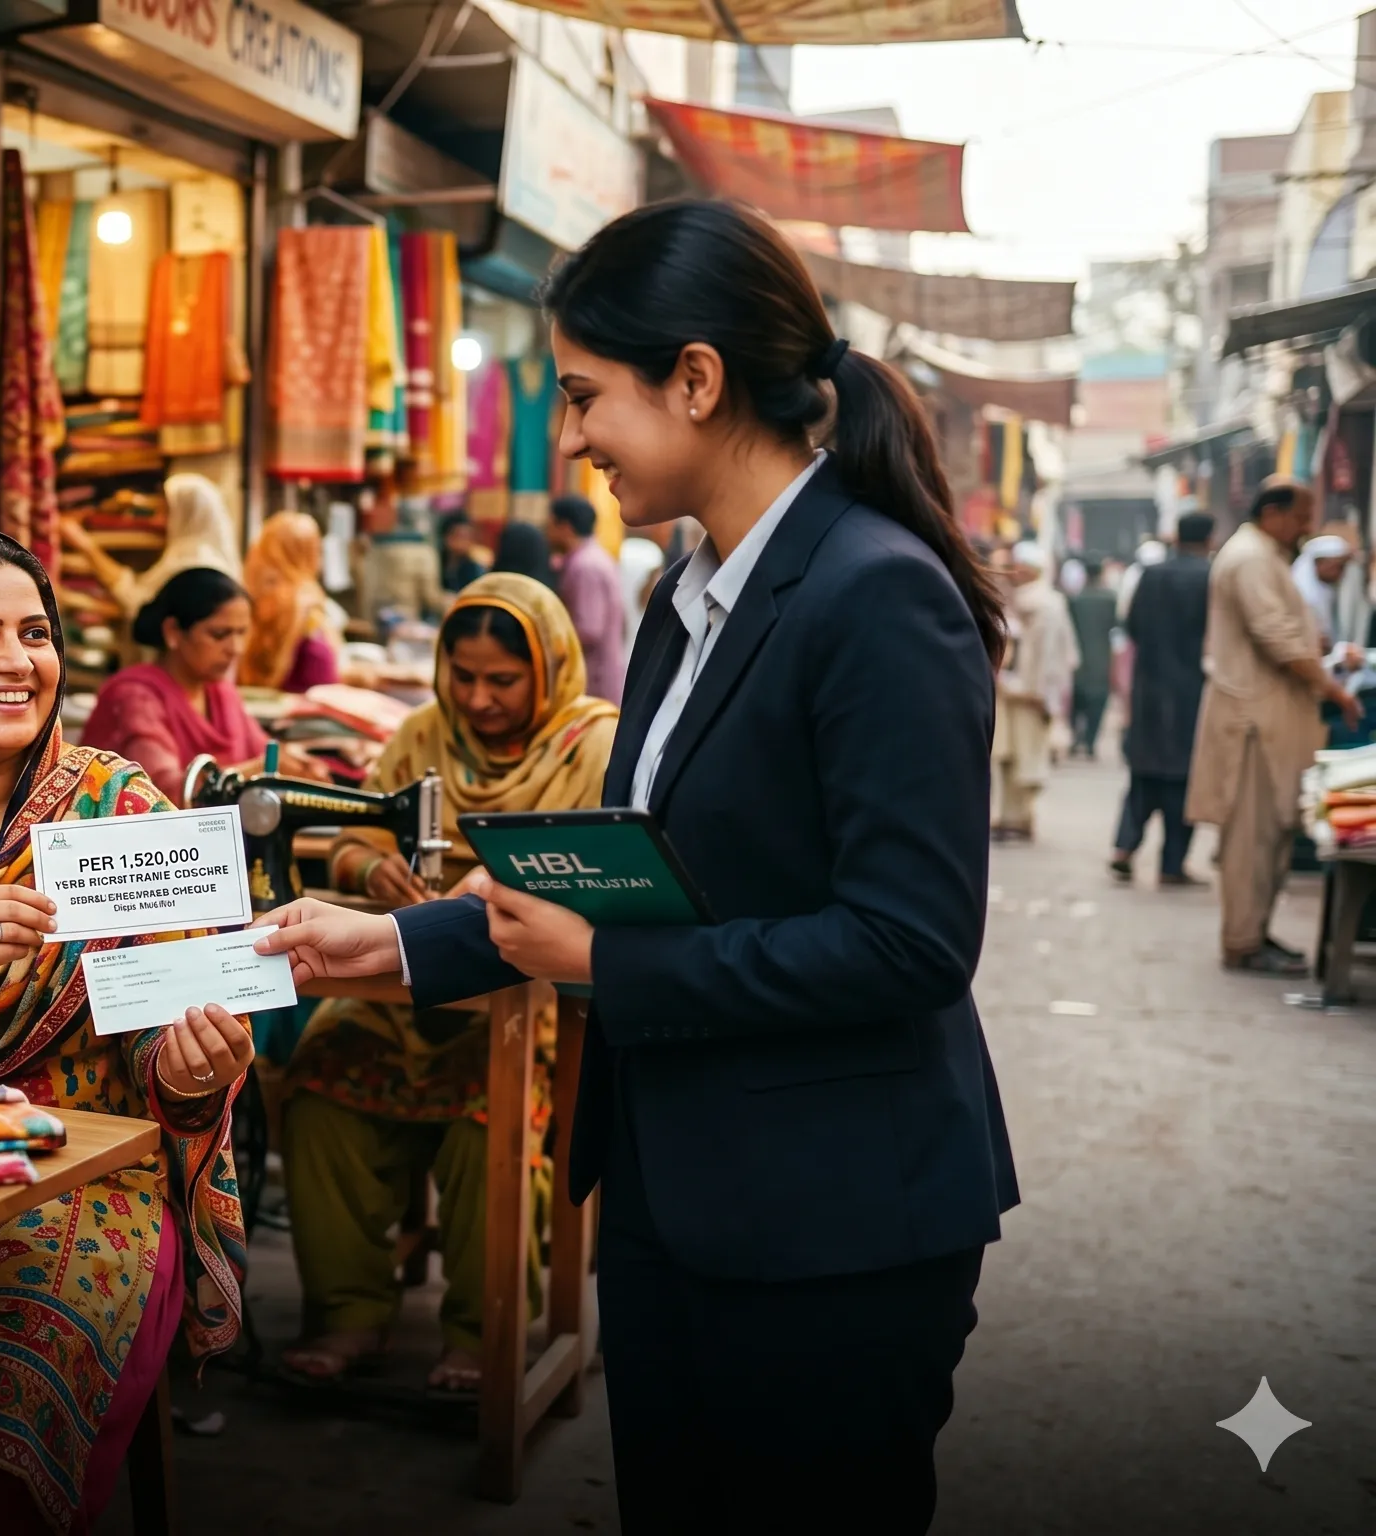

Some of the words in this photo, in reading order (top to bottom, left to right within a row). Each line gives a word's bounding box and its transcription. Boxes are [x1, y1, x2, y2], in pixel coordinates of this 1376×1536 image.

[79, 856, 114, 873] PER
[119, 847, 199, 870] 1,520,000
[509, 852, 603, 875] HBL
[172, 883, 217, 896] CHEQUE
